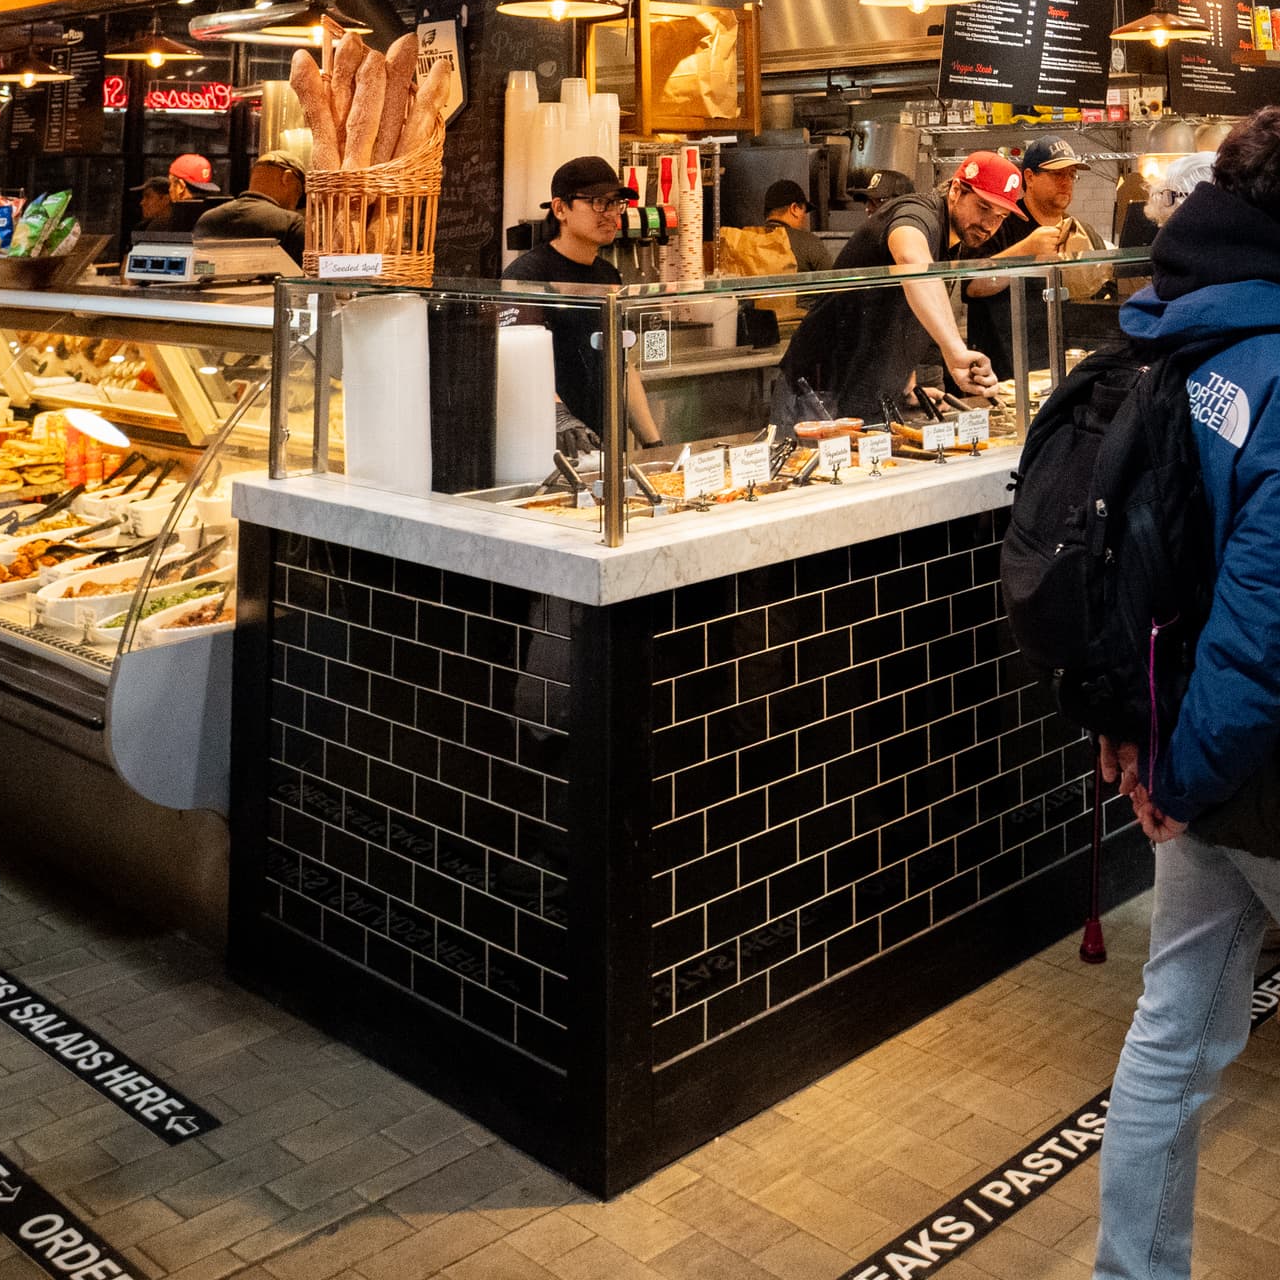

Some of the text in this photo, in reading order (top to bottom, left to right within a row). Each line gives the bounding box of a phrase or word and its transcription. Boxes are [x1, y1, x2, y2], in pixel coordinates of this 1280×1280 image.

[1207, 372, 1239, 400] THE
[9, 1003, 115, 1072] SALADS
[95, 1065, 184, 1121] HERE
